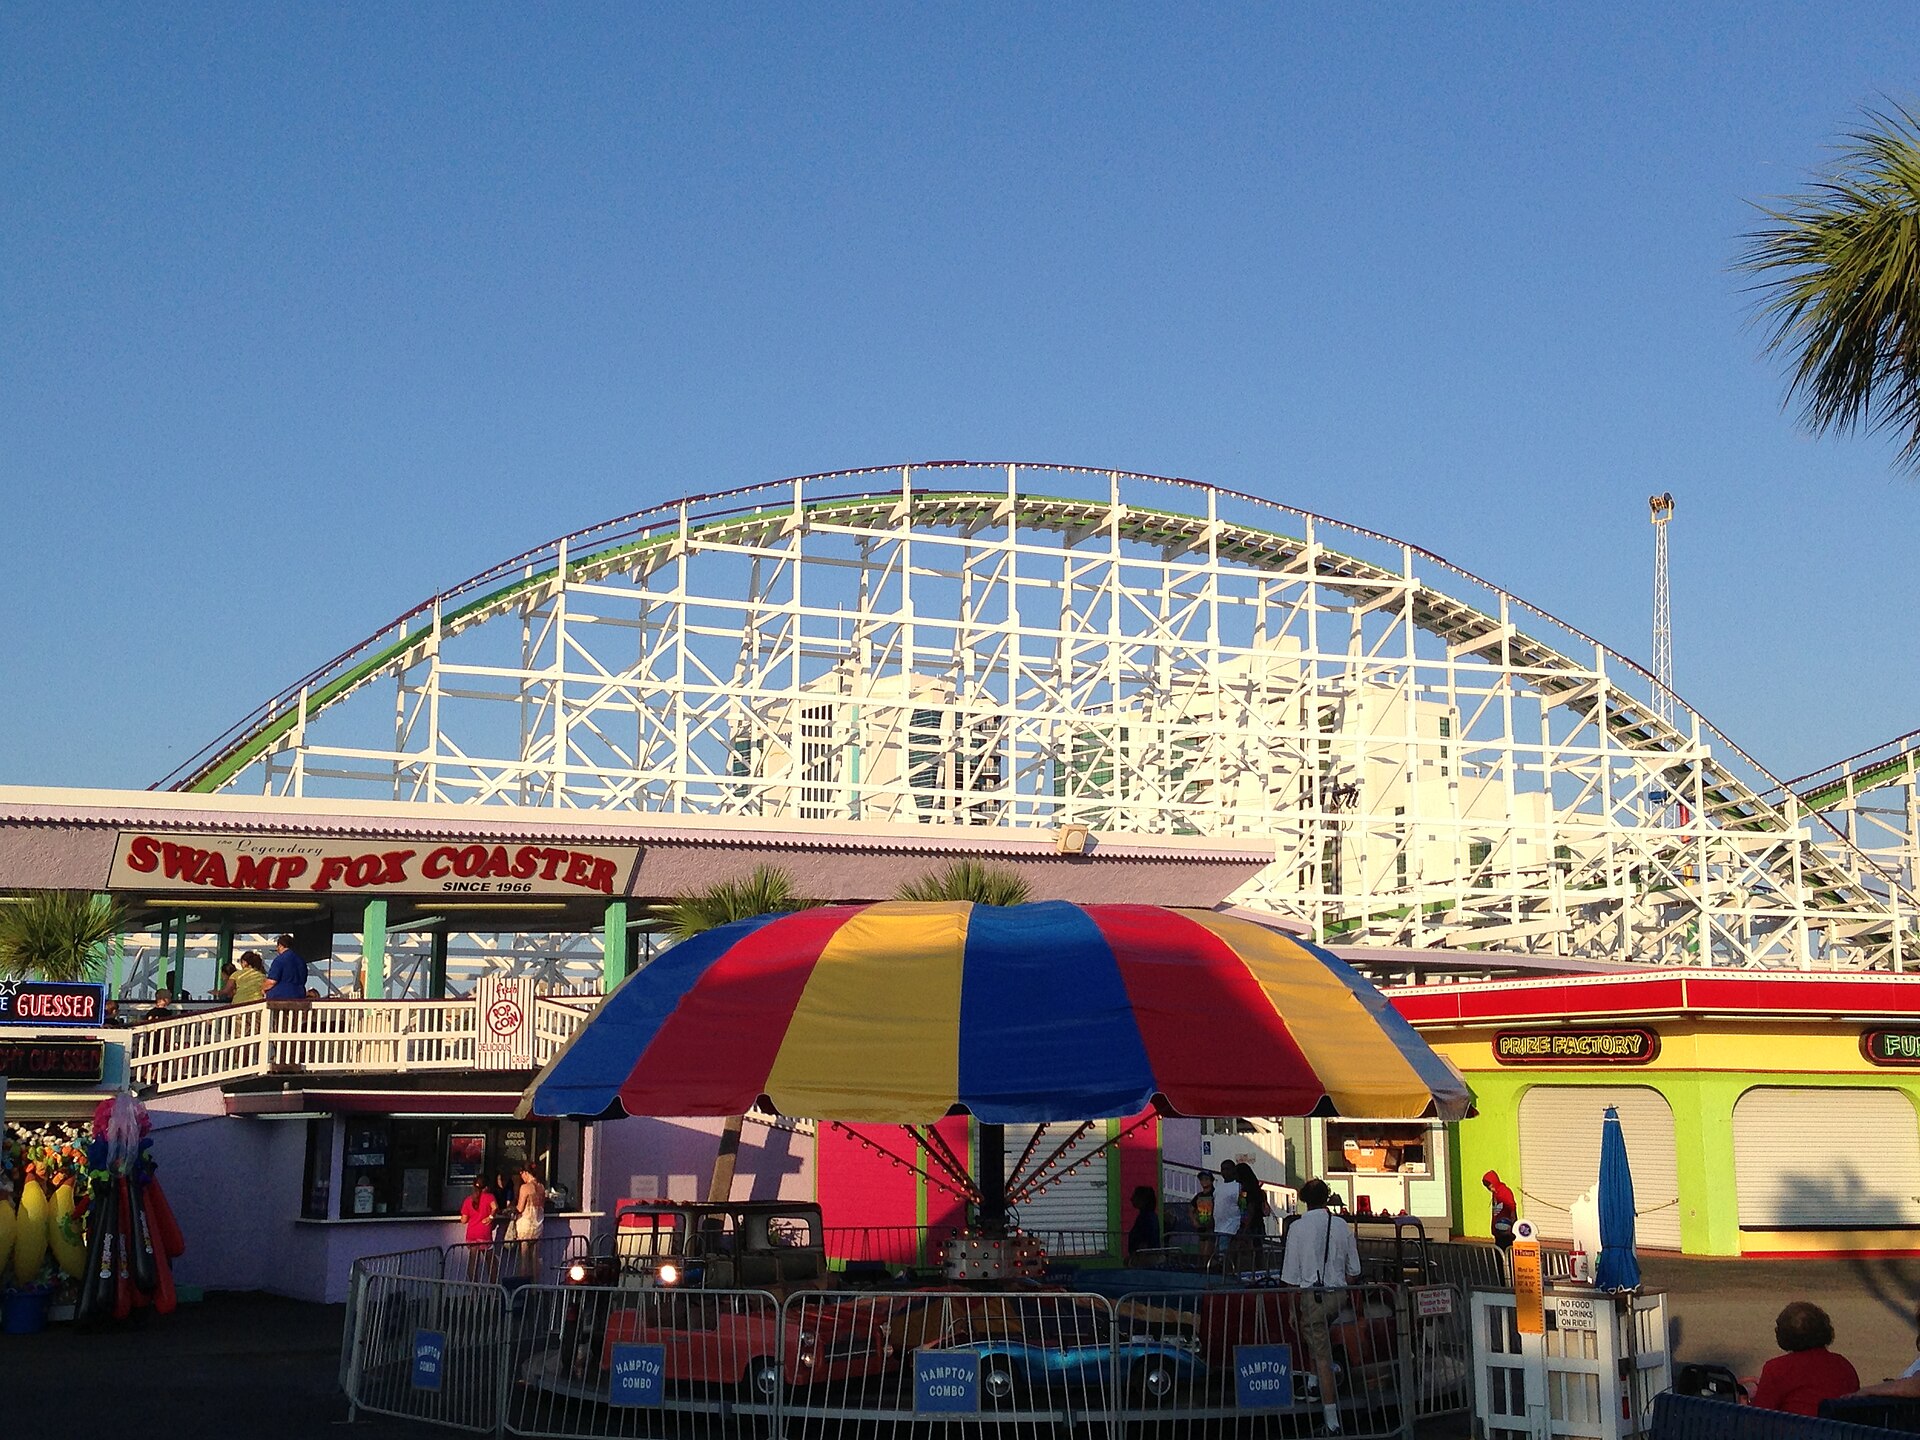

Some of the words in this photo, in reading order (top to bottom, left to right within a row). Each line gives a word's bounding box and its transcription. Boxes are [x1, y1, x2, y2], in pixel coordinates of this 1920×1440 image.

[236, 839, 323, 856] Legendary
[127, 836, 308, 890] SWAMP
[310, 850, 416, 891] FOX
[421, 845, 617, 895] COASTER
[442, 882, 491, 892] SINCE
[496, 882, 532, 892] 1966
[17, 994, 94, 1017] GUESSER
[493, 1004, 511, 1019] POP
[495, 1012, 518, 1030] CORN
[1500, 1037, 1550, 1054] PRIZE
[1553, 1034, 1643, 1054] FACTORY
[506, 1131, 525, 1139] ORDER
[1570, 1310, 1593, 1318] DRINKS
[616, 1360, 660, 1376] HAMPTON
[920, 1366, 974, 1383] HAMPTON
[1240, 1361, 1287, 1378] HAMPTON
[622, 1377, 652, 1389] COMBO
[929, 1385, 965, 1397] COMBO
[1249, 1379, 1280, 1391] COMBO
